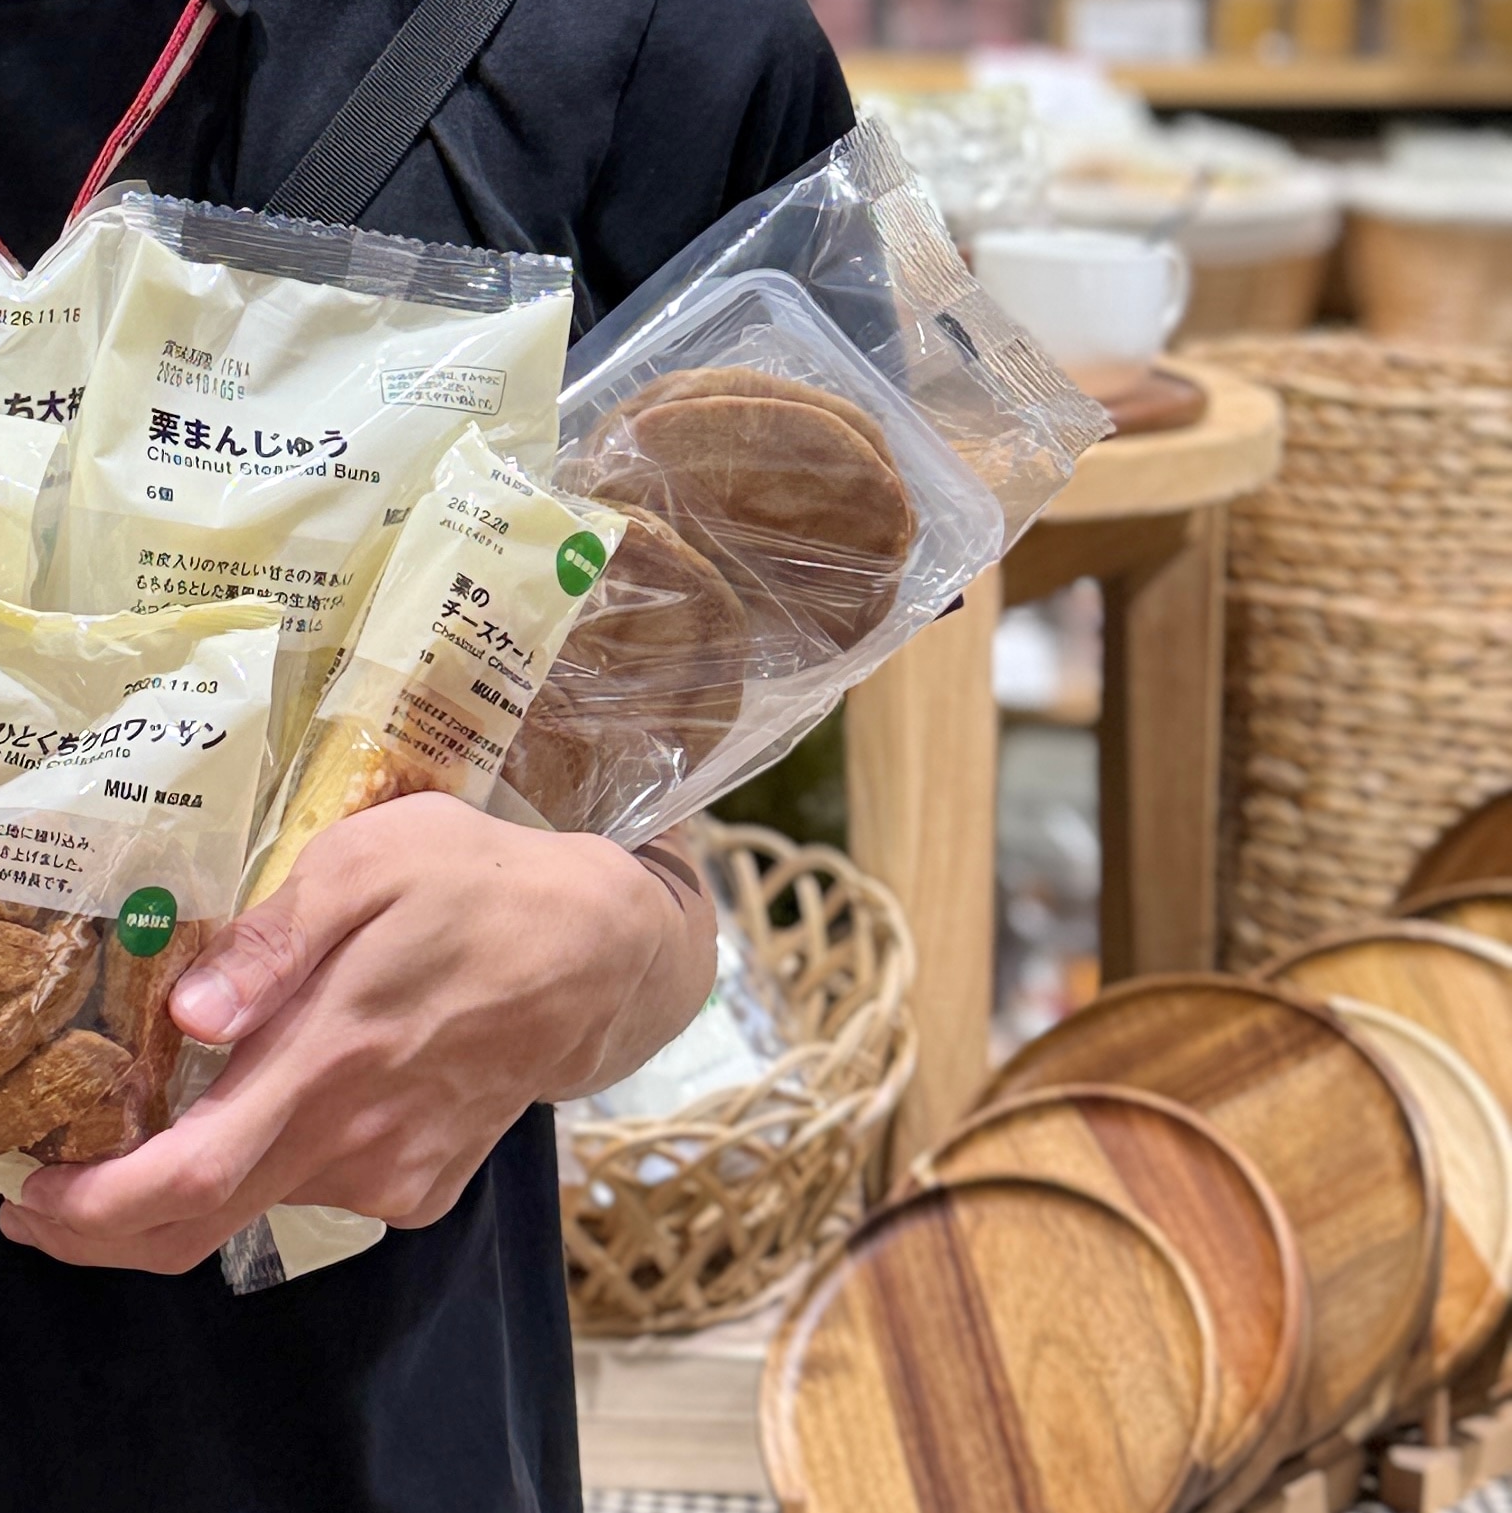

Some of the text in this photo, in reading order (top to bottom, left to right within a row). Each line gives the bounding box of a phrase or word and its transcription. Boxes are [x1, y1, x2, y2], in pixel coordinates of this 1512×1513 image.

[148, 407, 349, 459] 栗まんじゅう
[146, 446, 233, 476] Chestnut
[333, 462, 381, 485] Buns
[449, 572, 491, 609] 栗の
[103, 778, 149, 804] MUJI
